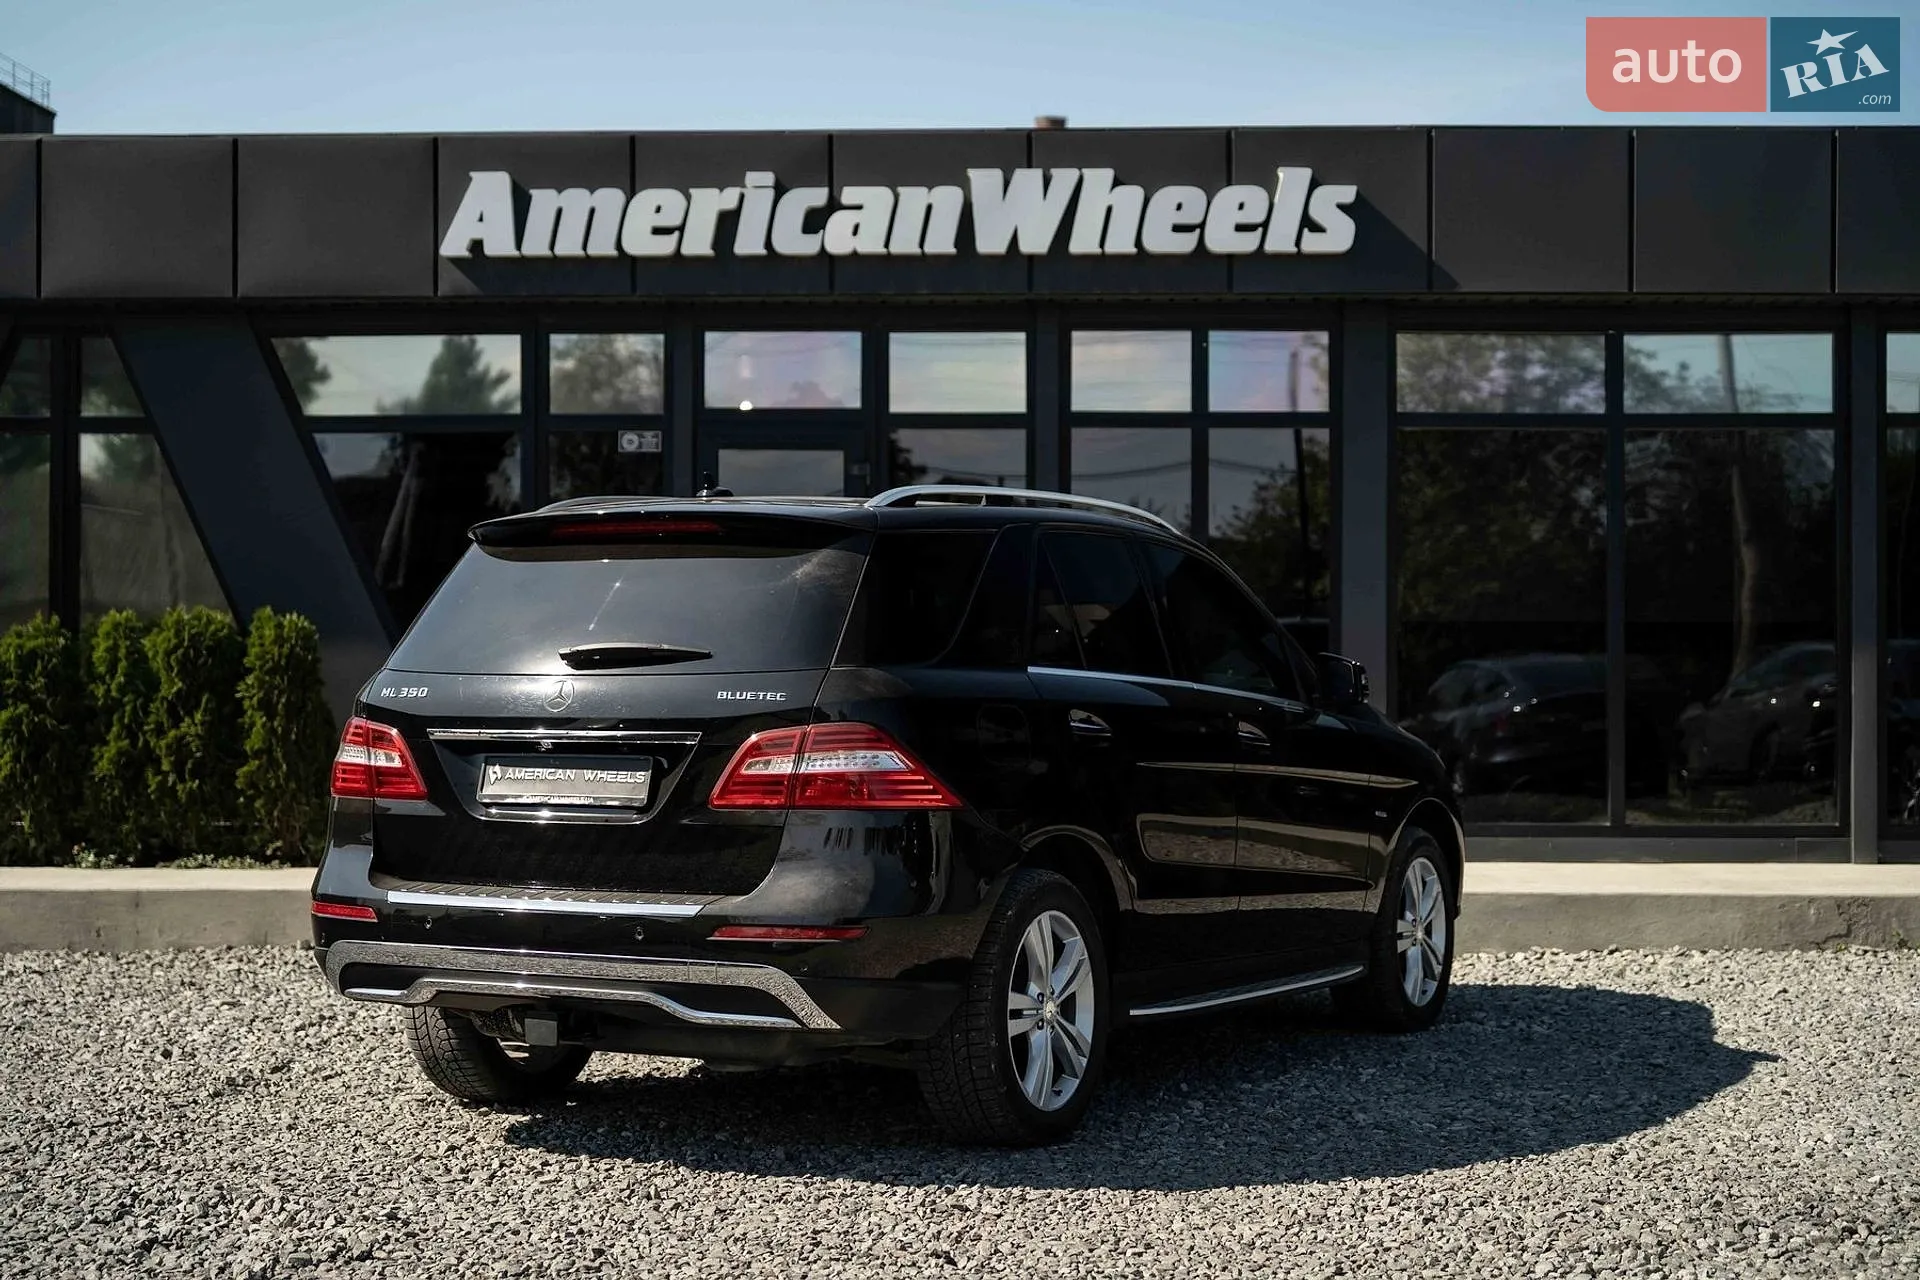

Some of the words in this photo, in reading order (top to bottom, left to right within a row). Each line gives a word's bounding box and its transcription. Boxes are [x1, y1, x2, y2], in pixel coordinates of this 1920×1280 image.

[380, 686, 397, 698] ML
[398, 686, 429, 698] 350
[717, 691, 787, 701] BLUETEC
[504, 768, 575, 782] AMERICAN
[583, 769, 645, 783] WHEELS
